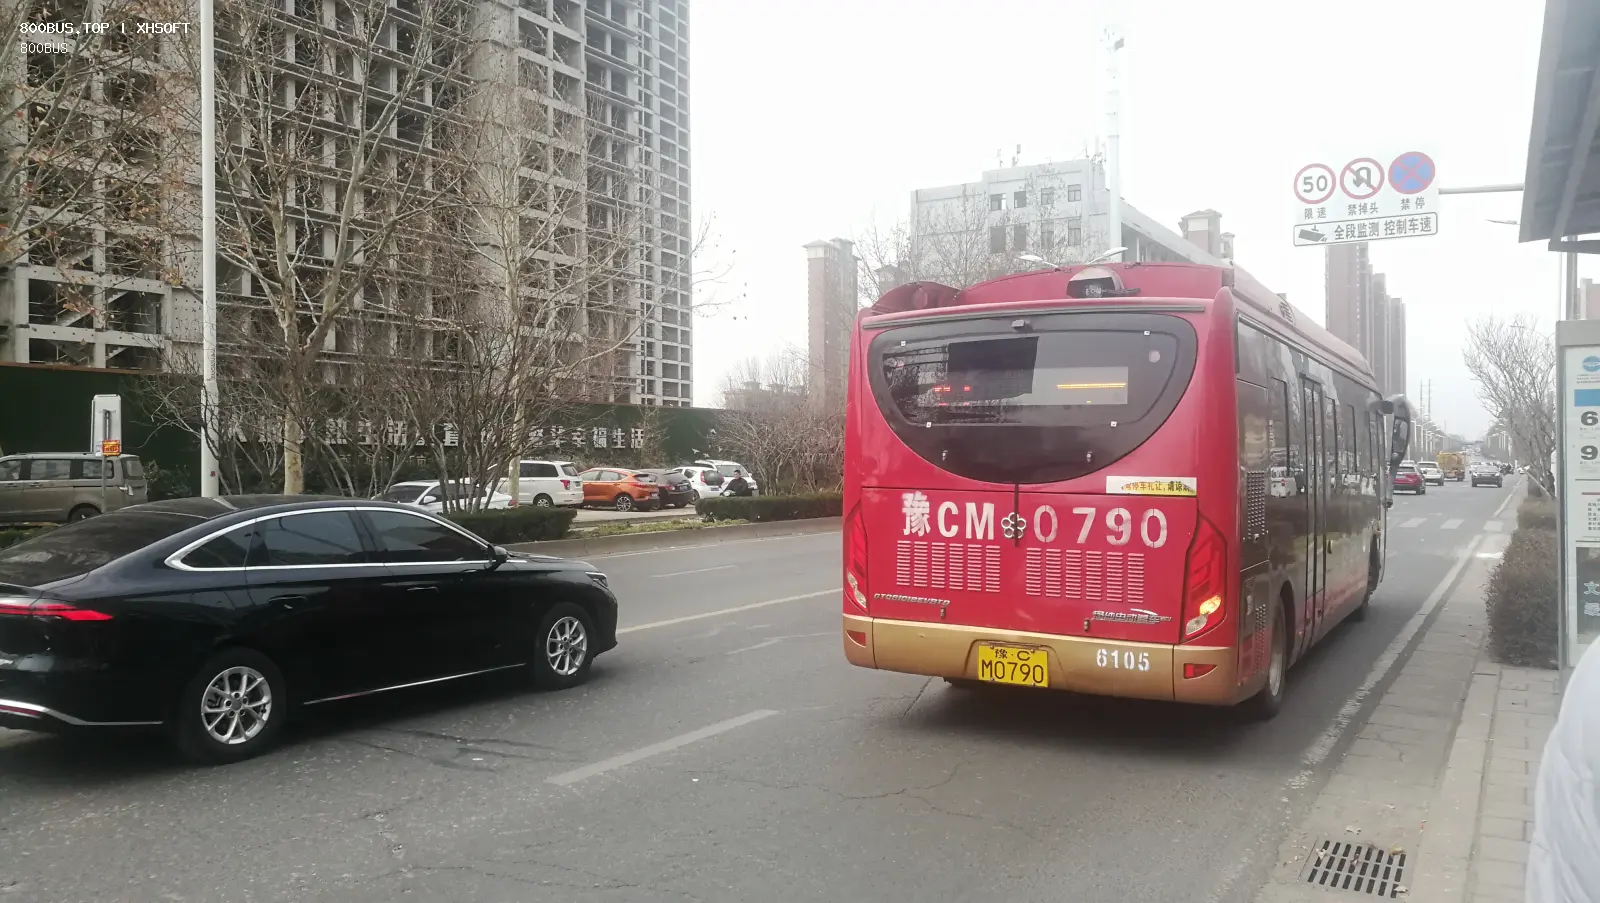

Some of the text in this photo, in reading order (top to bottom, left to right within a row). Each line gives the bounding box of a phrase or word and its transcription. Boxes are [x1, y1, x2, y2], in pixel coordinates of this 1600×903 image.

[1303, 174, 1328, 194] 50
[1347, 201, 1379, 216] 禁掉头
[1400, 197, 1426, 211] 禁停
[1304, 207, 1327, 220] 限速
[1334, 215, 1432, 241] 全段监测 控制车速
[1581, 411, 1598, 426] 6
[1581, 445, 1598, 460] 9
[901, 491, 1168, 549] 豫CM 0790
[995, 648, 1031, 662] 豫·C
[1096, 648, 1151, 672] 6105
[981, 659, 1045, 684] M0790
